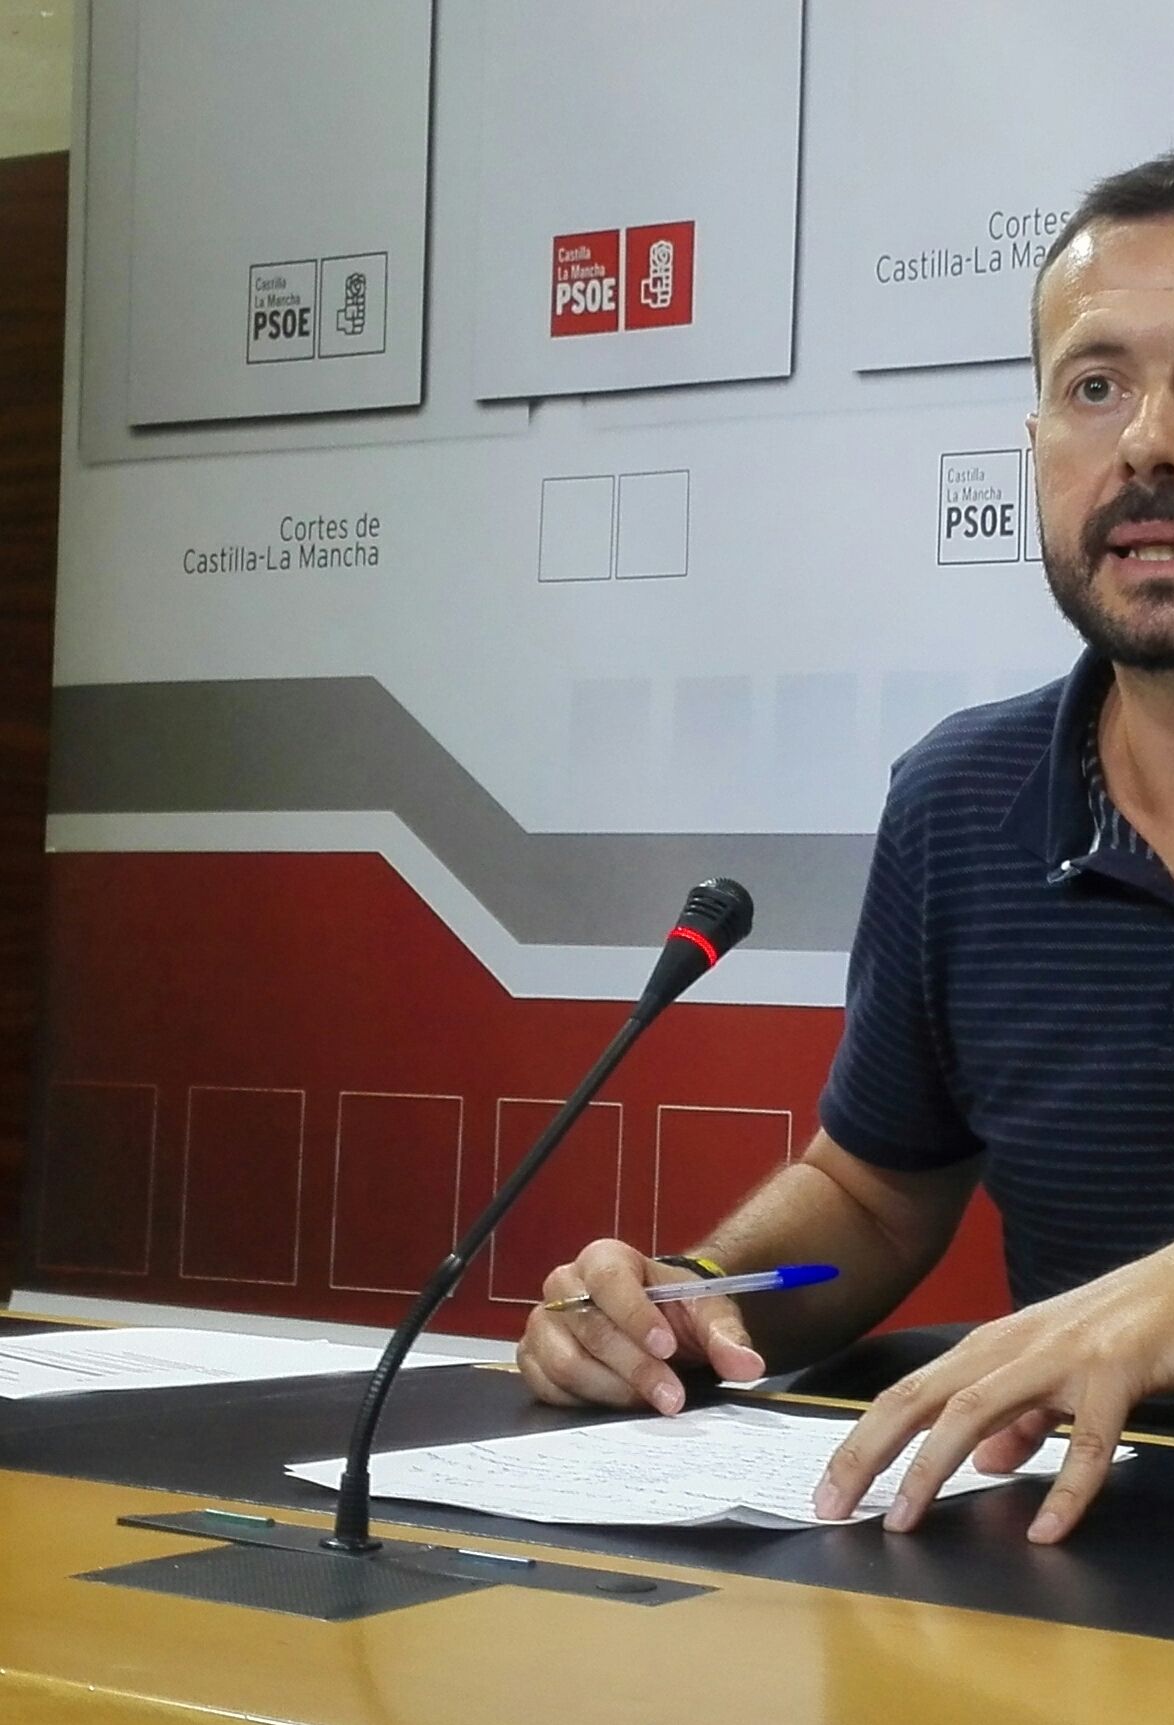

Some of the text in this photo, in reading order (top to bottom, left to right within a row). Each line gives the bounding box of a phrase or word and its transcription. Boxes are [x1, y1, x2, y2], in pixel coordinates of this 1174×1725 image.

[559, 245, 591, 263] Castilla
[876, 246, 1001, 283] Castilla-La
[558, 263, 605, 281] La Mancha
[255, 293, 300, 308] La Mancha
[556, 277, 616, 315] PSOE
[253, 307, 311, 341] PSOE
[947, 467, 985, 483] Castilla
[946, 486, 1002, 503] La Mancha
[280, 512, 380, 541] Cortes de
[946, 503, 1014, 539] PSOE
[183, 542, 379, 574] Castilla-La Mancha
